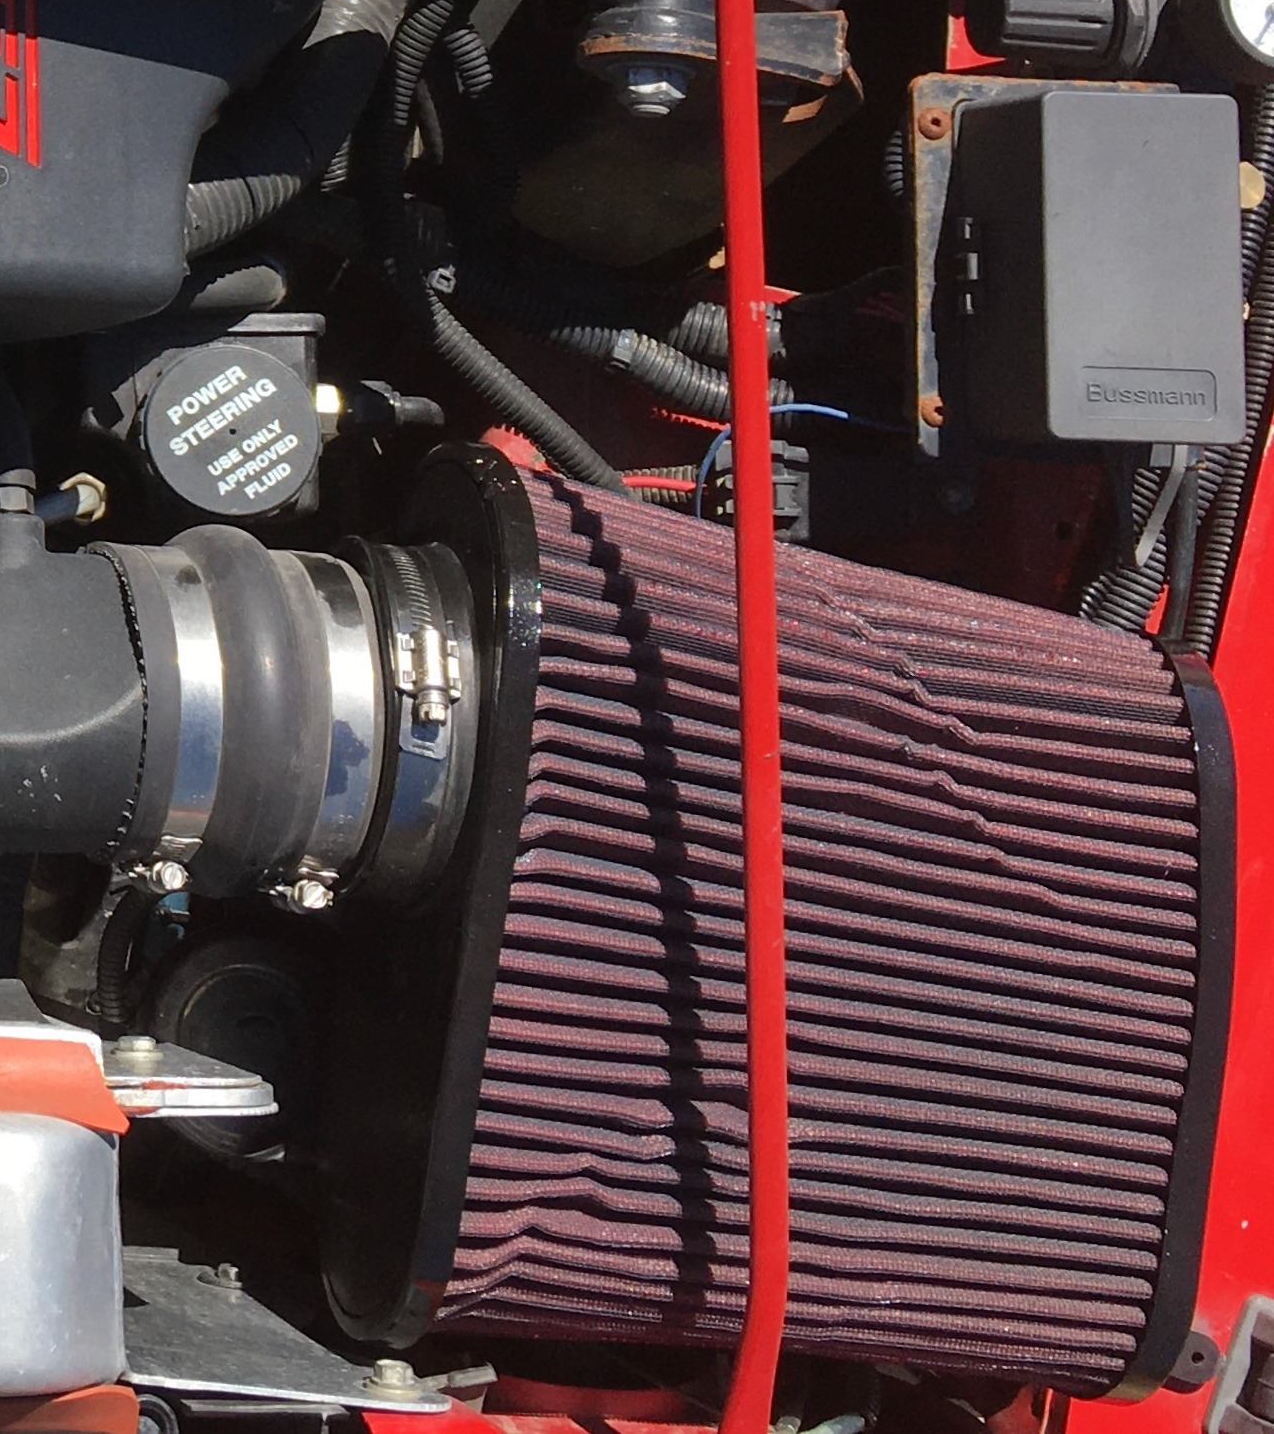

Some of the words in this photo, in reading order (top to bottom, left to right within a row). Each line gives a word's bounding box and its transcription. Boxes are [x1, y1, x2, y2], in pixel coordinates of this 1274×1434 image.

[166, 365, 248, 425] POWER
[169, 378, 278, 455] STEERING
[1086, 382, 1207, 406] Bussmann
[207, 448, 244, 476] USE
[242, 419, 283, 454] ONLY
[217, 434, 299, 496] APPROVED
[244, 462, 292, 499] FLUID
